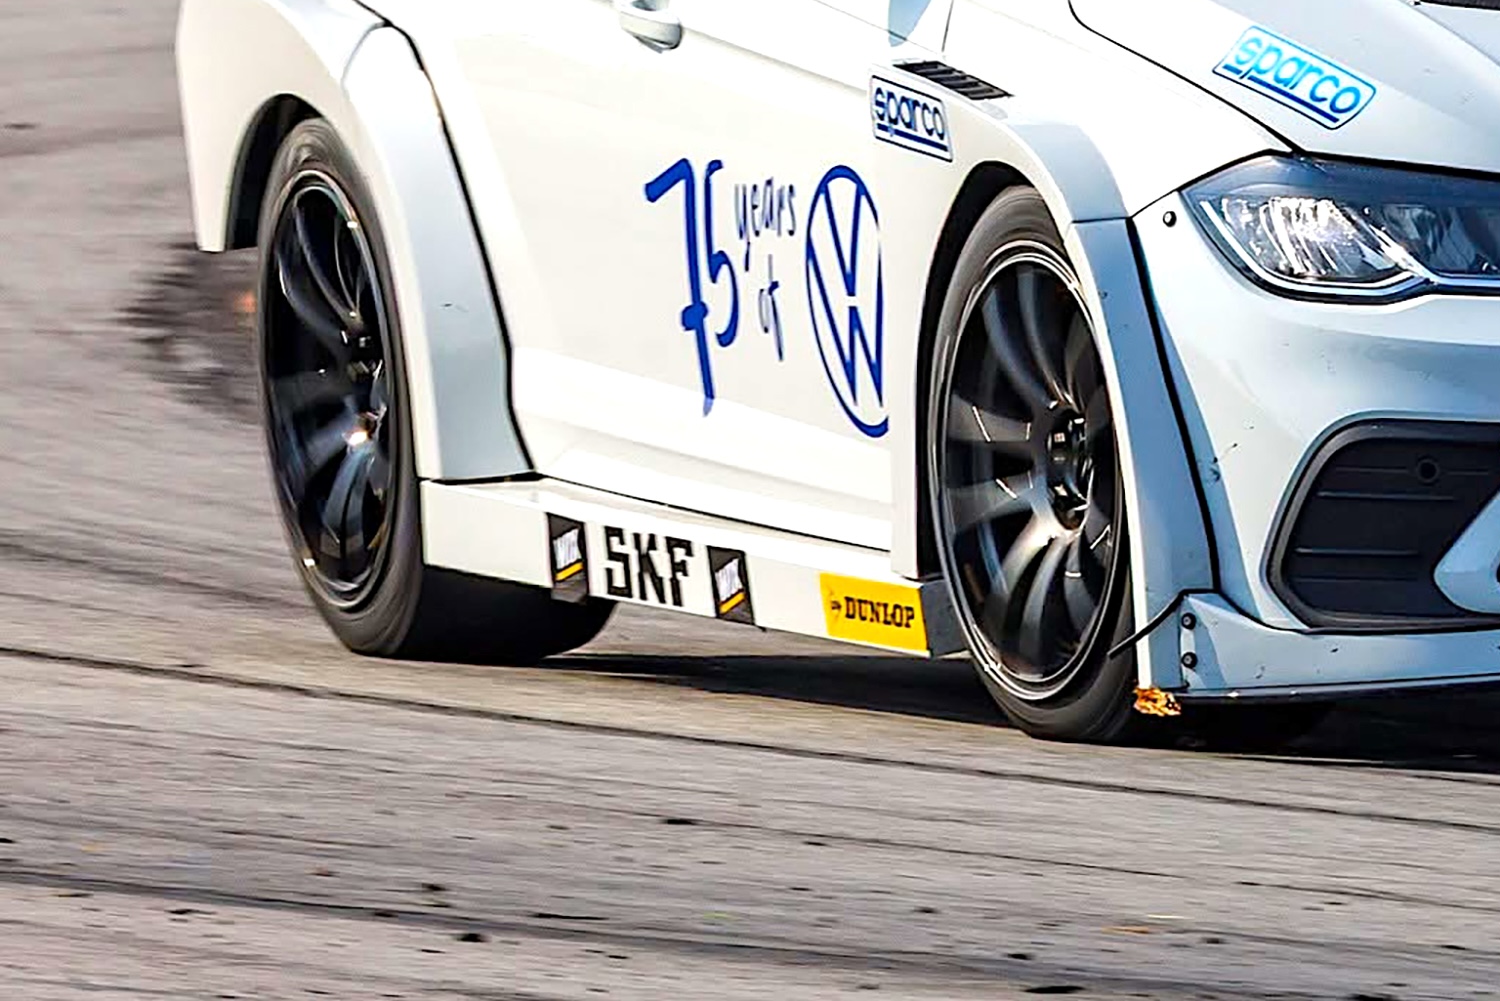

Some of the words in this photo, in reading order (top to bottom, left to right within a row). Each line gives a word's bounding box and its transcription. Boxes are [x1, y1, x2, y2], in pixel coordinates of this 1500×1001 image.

[875, 87, 945, 141] sparco
[1234, 36, 1361, 114] sparco
[734, 176, 797, 272] years
[644, 158, 740, 416] 75
[758, 253, 784, 362] of
[604, 525, 695, 608] SKF
[844, 596, 915, 629] DUNLOP
